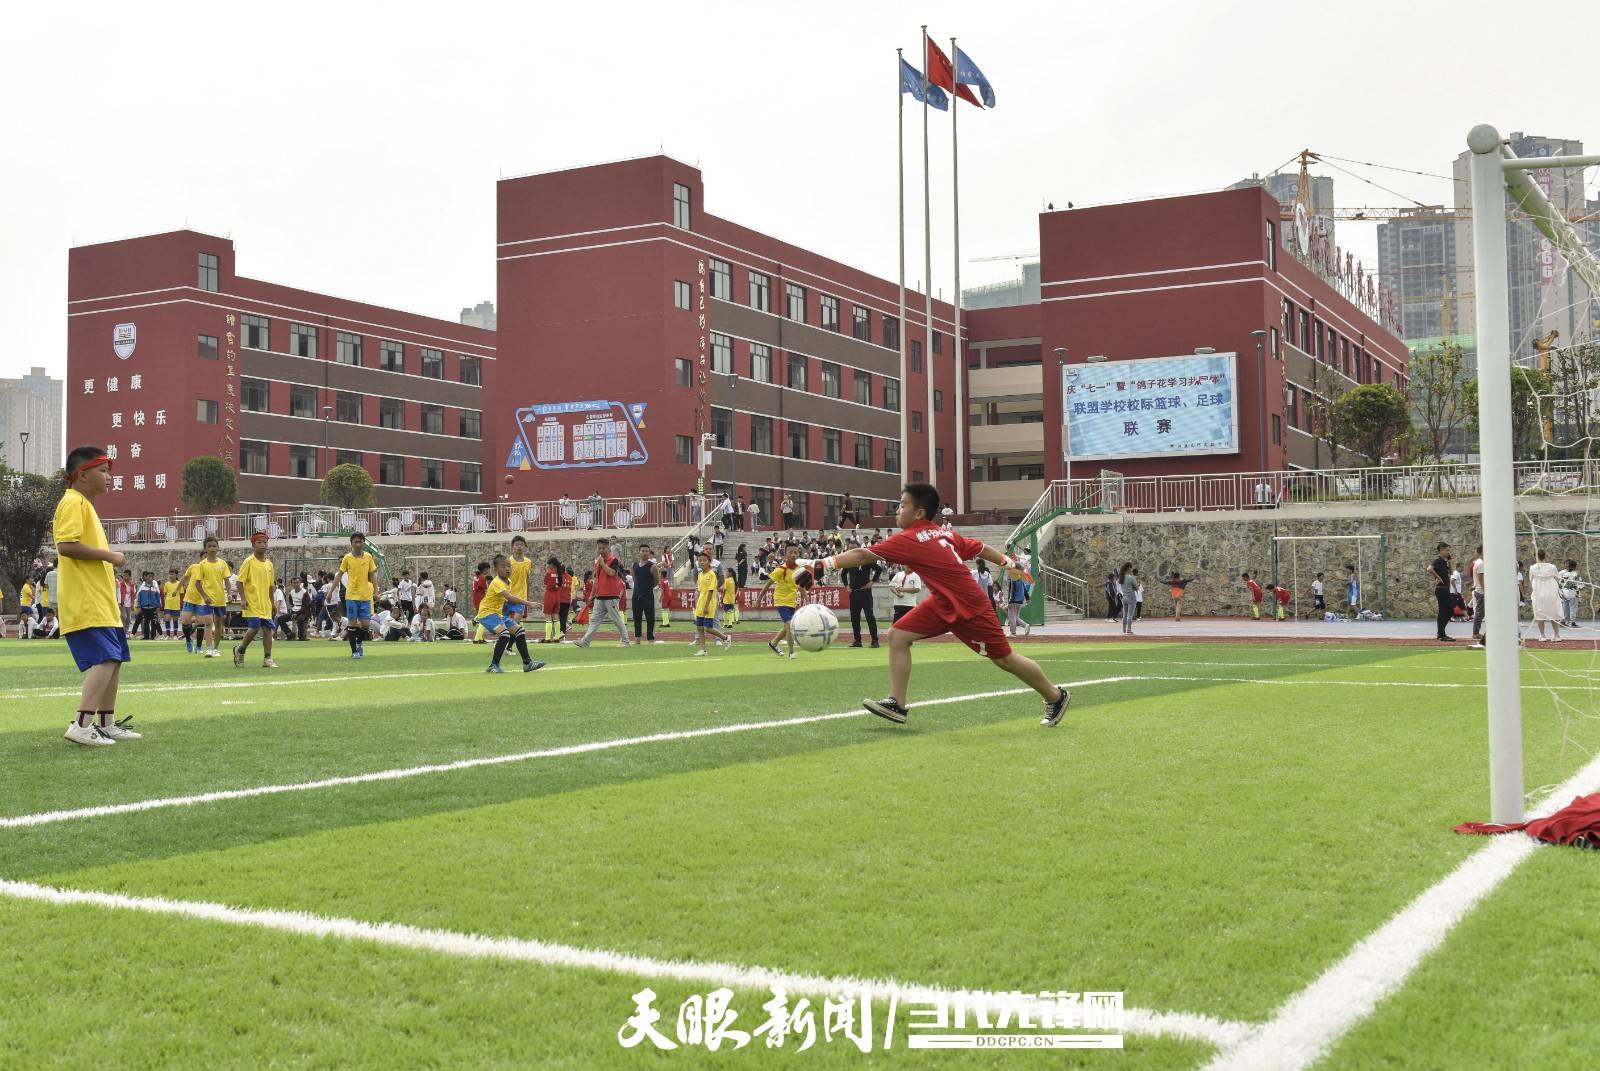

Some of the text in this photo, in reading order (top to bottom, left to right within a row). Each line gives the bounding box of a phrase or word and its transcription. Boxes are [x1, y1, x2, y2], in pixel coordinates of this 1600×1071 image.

[83, 374, 142, 394] 更健康
[1073, 392, 1224, 415] 联盟学校校际篮球、足球
[111, 409, 167, 429] 更快乐
[938, 538, 963, 565] 7
